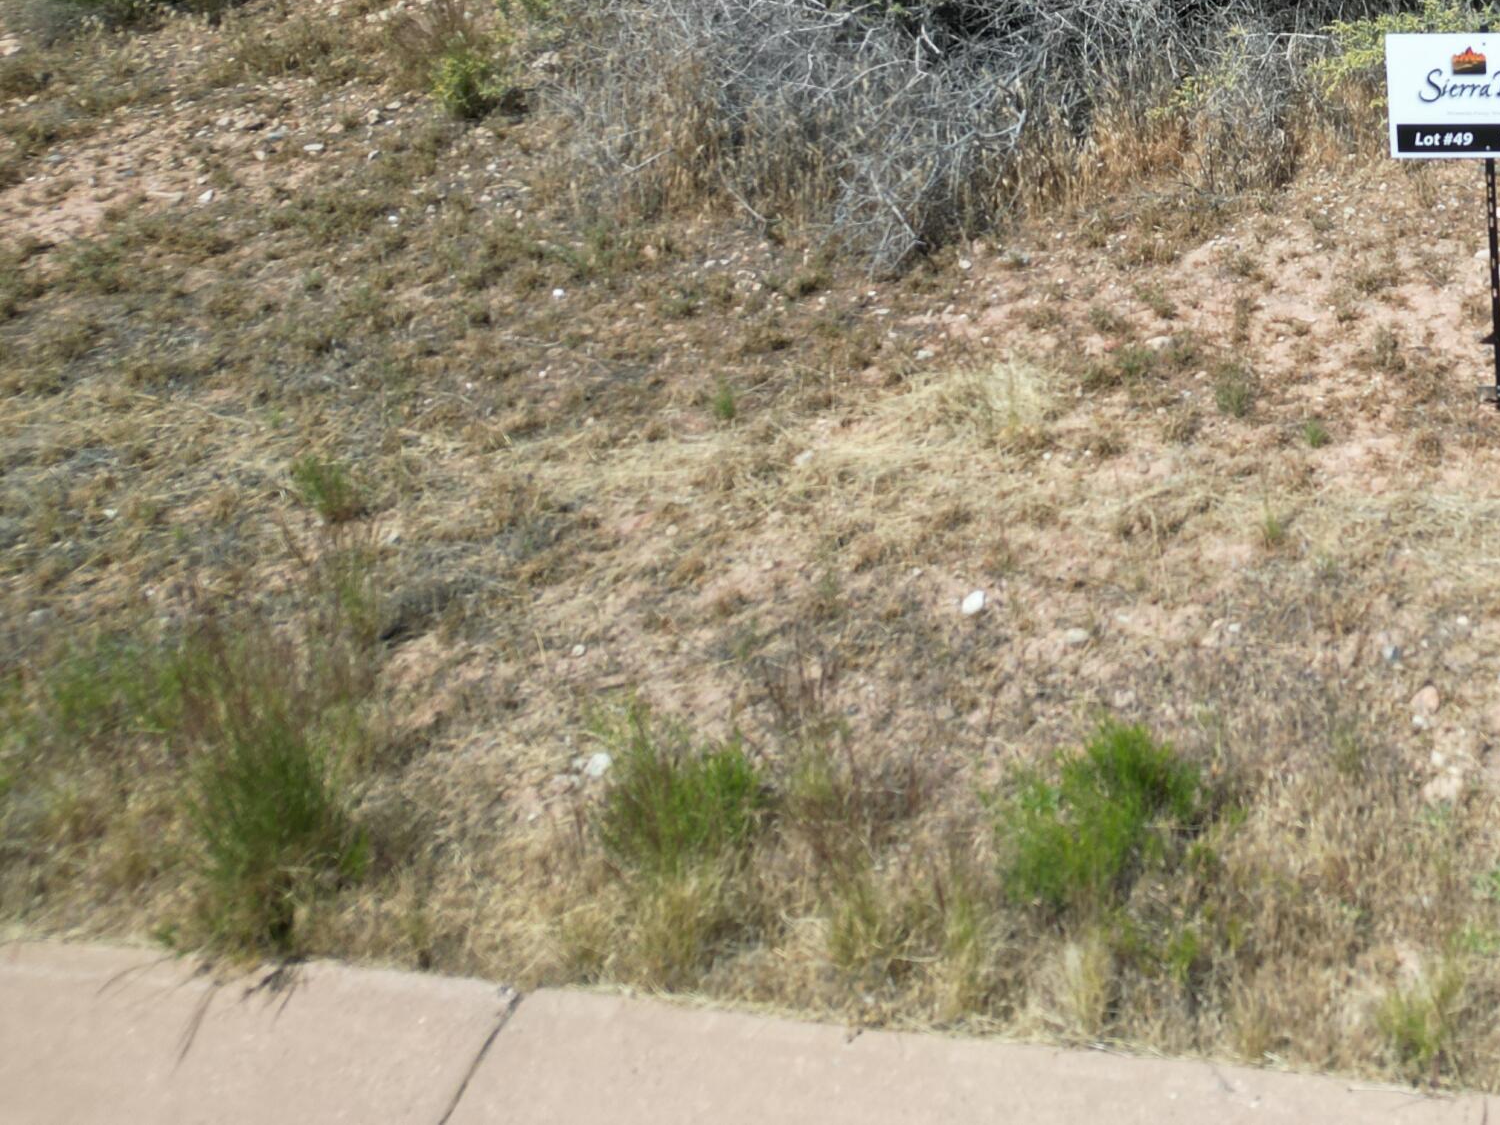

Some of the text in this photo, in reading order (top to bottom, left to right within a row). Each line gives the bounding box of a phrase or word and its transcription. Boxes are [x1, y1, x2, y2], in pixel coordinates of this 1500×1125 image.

[1418, 68, 1490, 103] Sierra
[1414, 132, 1474, 146] Lot #49
